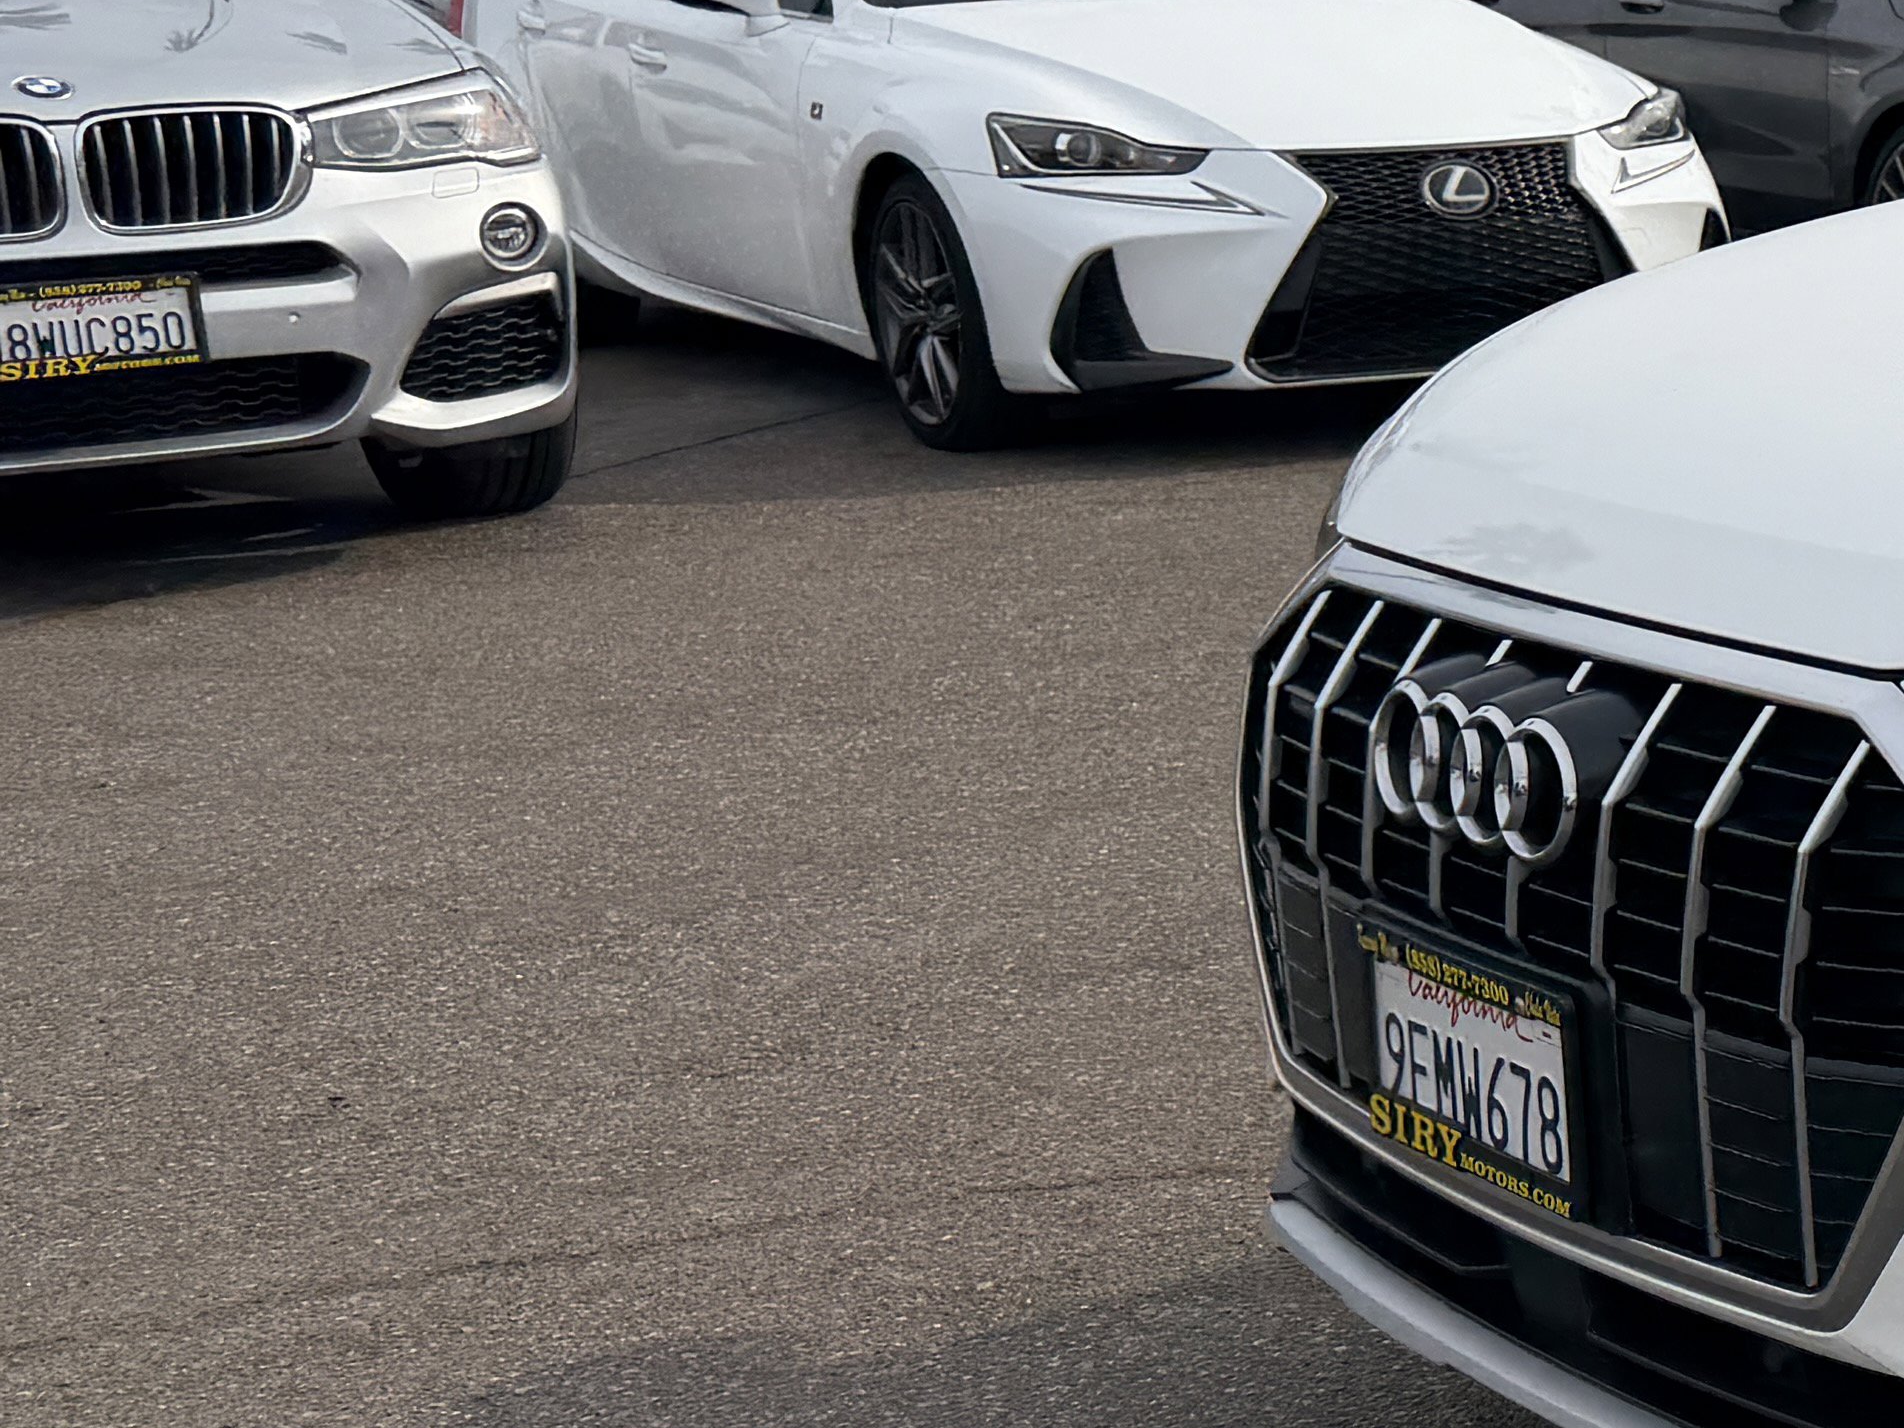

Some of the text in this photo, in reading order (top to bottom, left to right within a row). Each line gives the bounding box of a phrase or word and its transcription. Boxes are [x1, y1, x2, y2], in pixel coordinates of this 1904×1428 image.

[0, 355, 95, 382] SIRY
[7, 311, 187, 363] 8WUC850
[1385, 1012, 1563, 1176] 9EMW678
[1369, 1092, 1462, 1169] SIRY
[1461, 1152, 1571, 1220] MOTORS.COM
